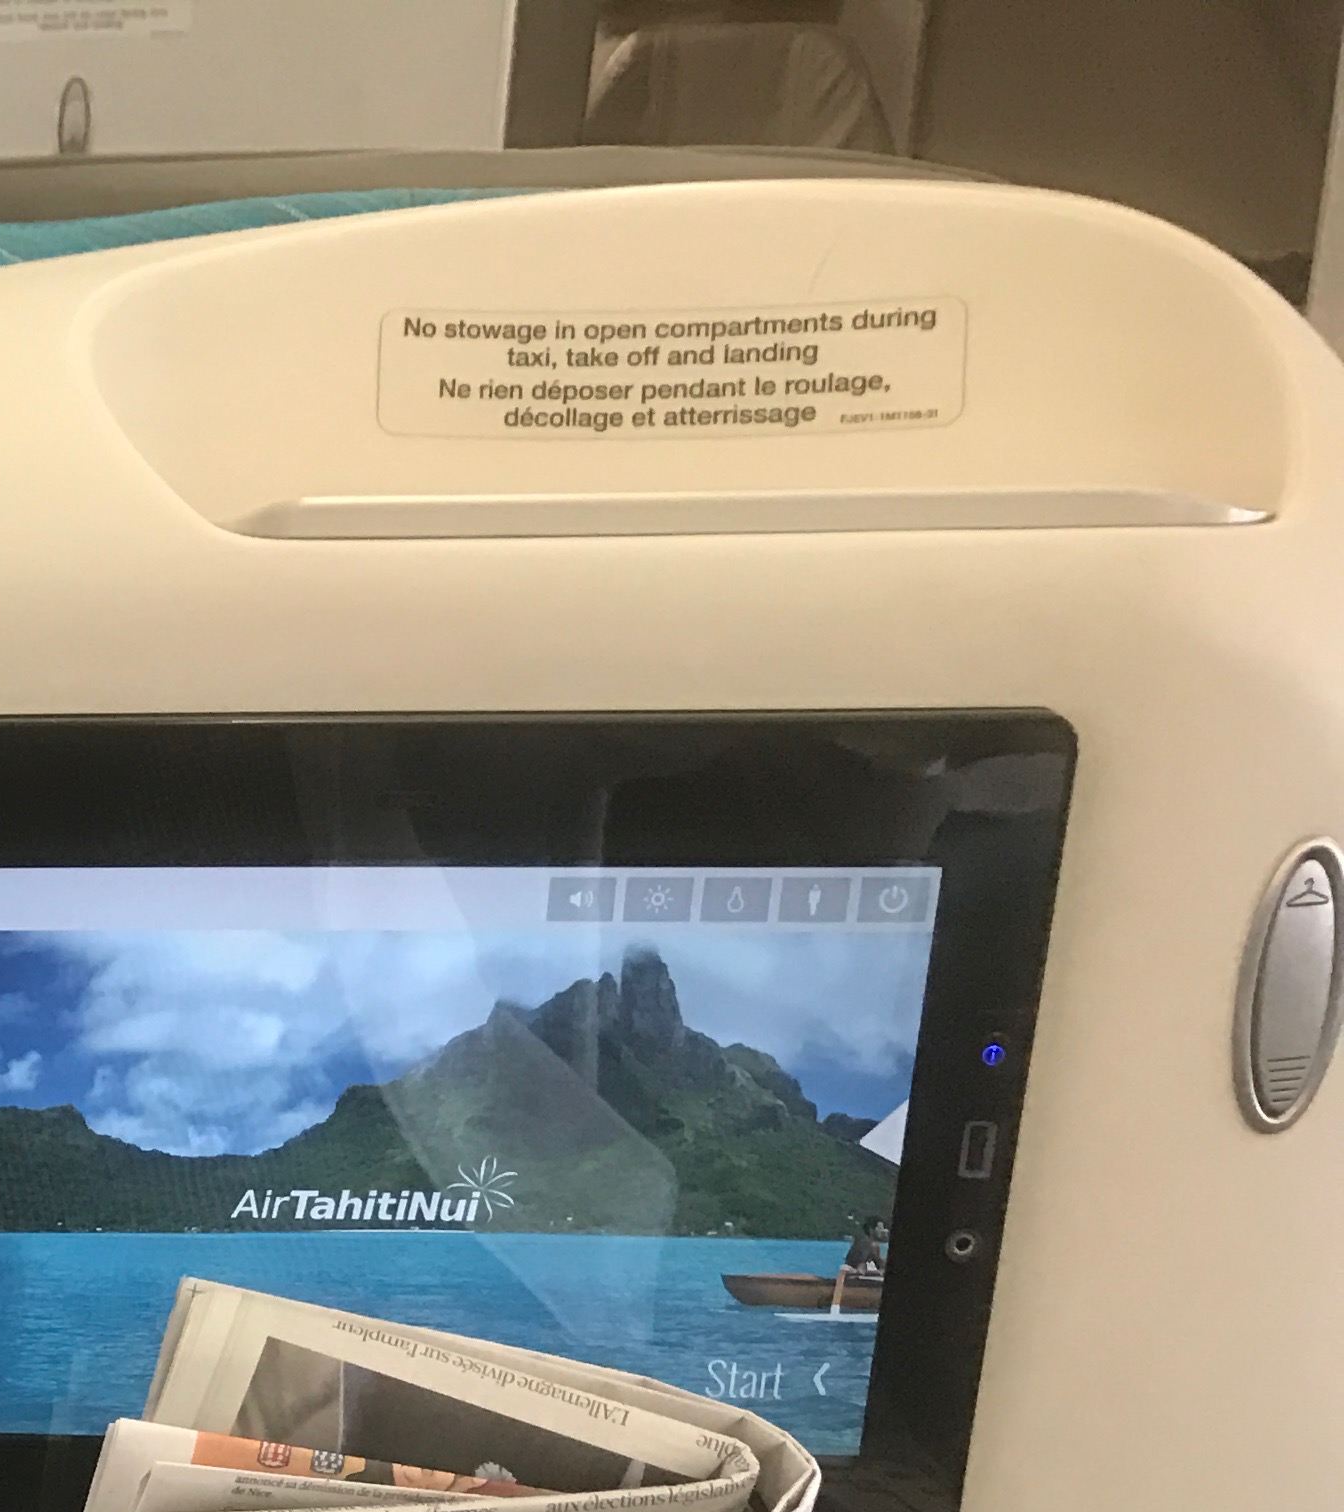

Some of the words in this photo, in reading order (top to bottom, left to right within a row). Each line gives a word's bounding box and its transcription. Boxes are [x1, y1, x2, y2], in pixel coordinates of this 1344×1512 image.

[404, 318, 436, 338] No
[445, 320, 546, 344] stowage
[556, 320, 575, 339] in
[584, 324, 646, 344] open
[655, 313, 842, 342] compartments
[851, 308, 936, 330] during
[507, 347, 557, 369] taxi,
[566, 347, 618, 367] take
[627, 346, 660, 366] off
[668, 345, 714, 365] and
[724, 342, 818, 365] landing
[439, 378, 471, 398] Ne
[480, 379, 522, 399] rien
[532, 380, 633, 404] déposer
[641, 378, 745, 404] pendant
[755, 376, 776, 395] le
[785, 373, 890, 396] roulage,
[504, 407, 623, 432] décollage
[632, 408, 655, 427] et
[664, 405, 816, 428] atterrissage
[231, 1188, 482, 1222] AirTahitiNui
[332, 1319, 418, 1358] l'ampleur
[418, 1347, 450, 1371] sur
[451, 1355, 516, 1389] divisée
[705, 1359, 784, 1400] Start
[517, 1374, 630, 1427] L'Allemagne
